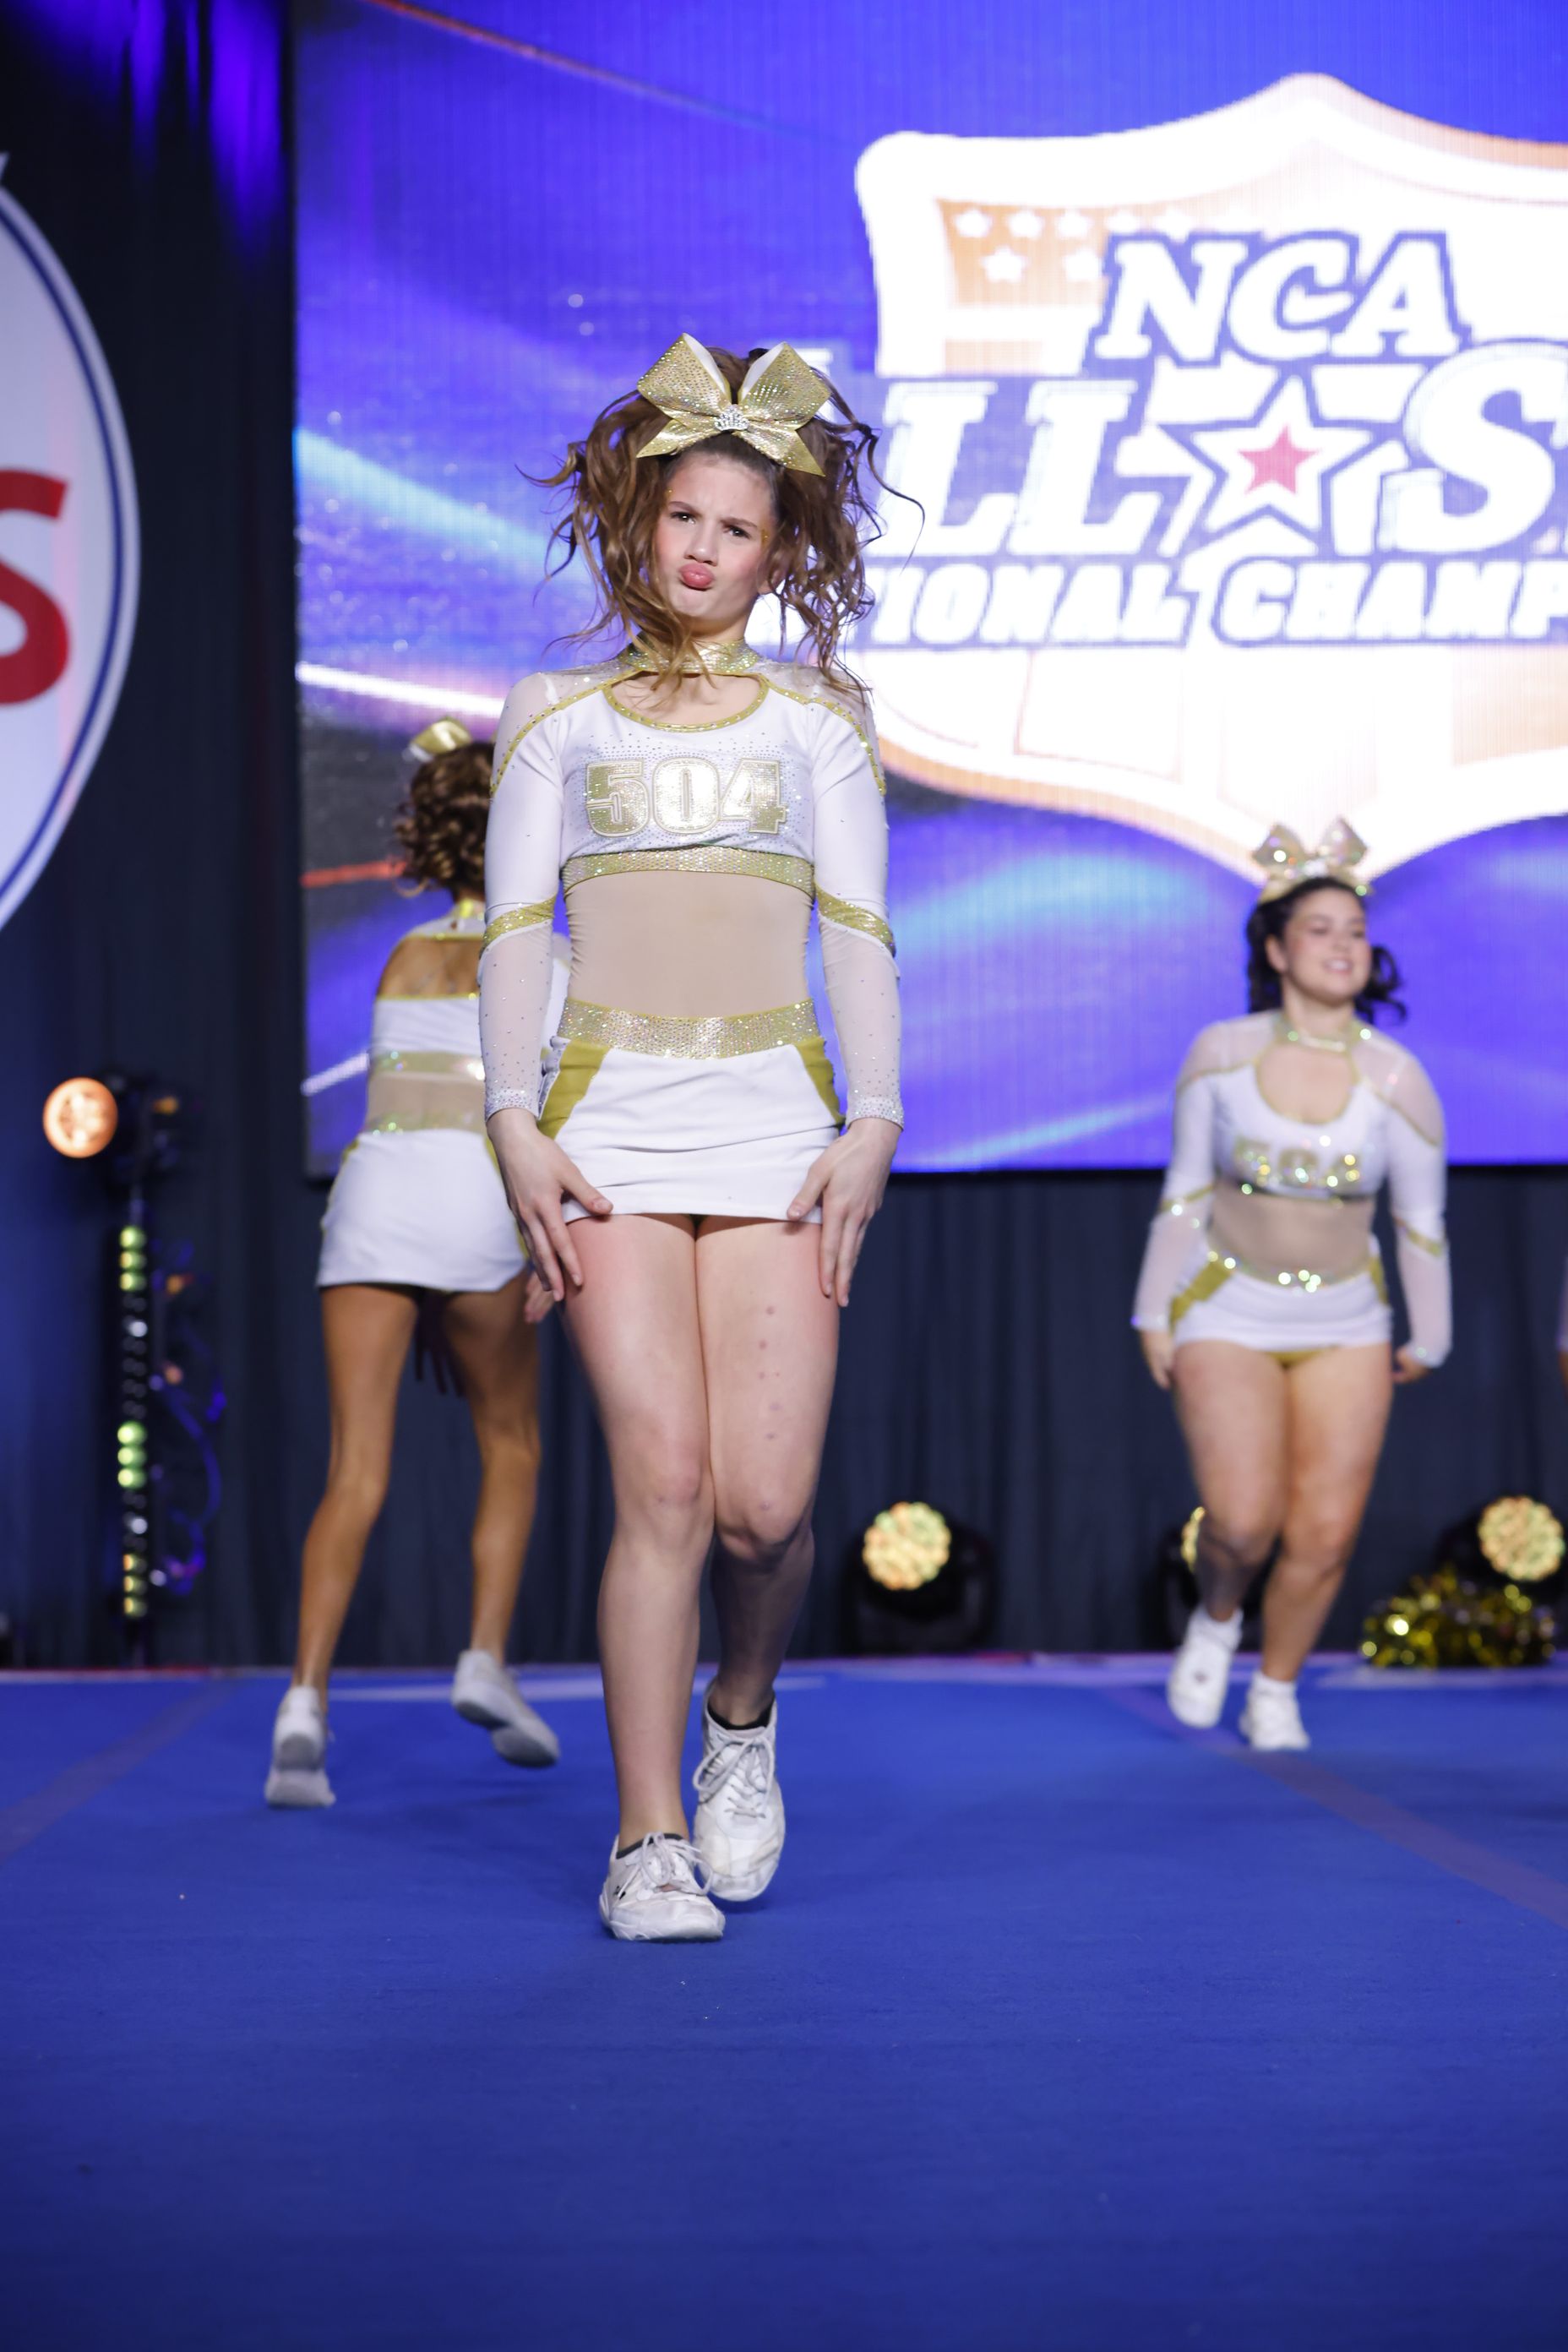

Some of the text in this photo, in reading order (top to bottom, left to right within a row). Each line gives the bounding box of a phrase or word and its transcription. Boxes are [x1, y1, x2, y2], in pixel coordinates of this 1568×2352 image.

[1093, 235, 1463, 363] NCA
[787, 348, 1164, 556] LL
[586, 758, 787, 837] 504
